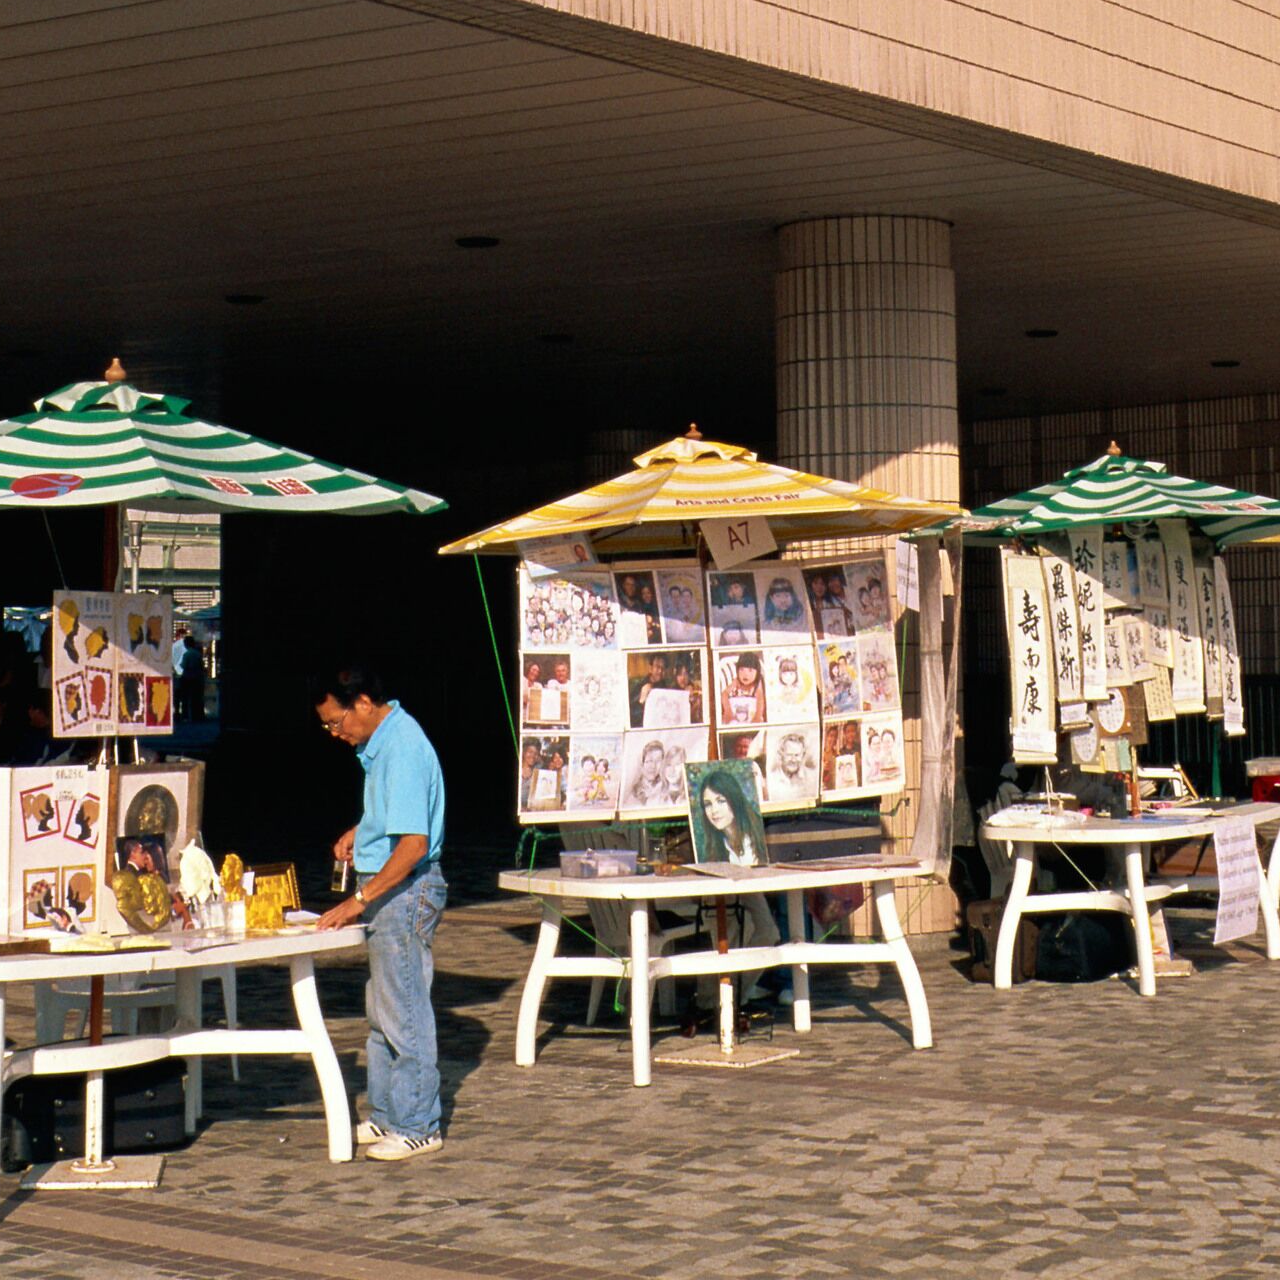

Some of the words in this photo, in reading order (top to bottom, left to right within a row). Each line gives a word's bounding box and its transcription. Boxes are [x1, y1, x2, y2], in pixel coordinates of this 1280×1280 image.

[674, 498, 702, 507] Arts
[705, 497, 730, 506] and
[732, 494, 772, 505] Crafts
[775, 492, 801, 501] Fair
[727, 520, 751, 551] A7
